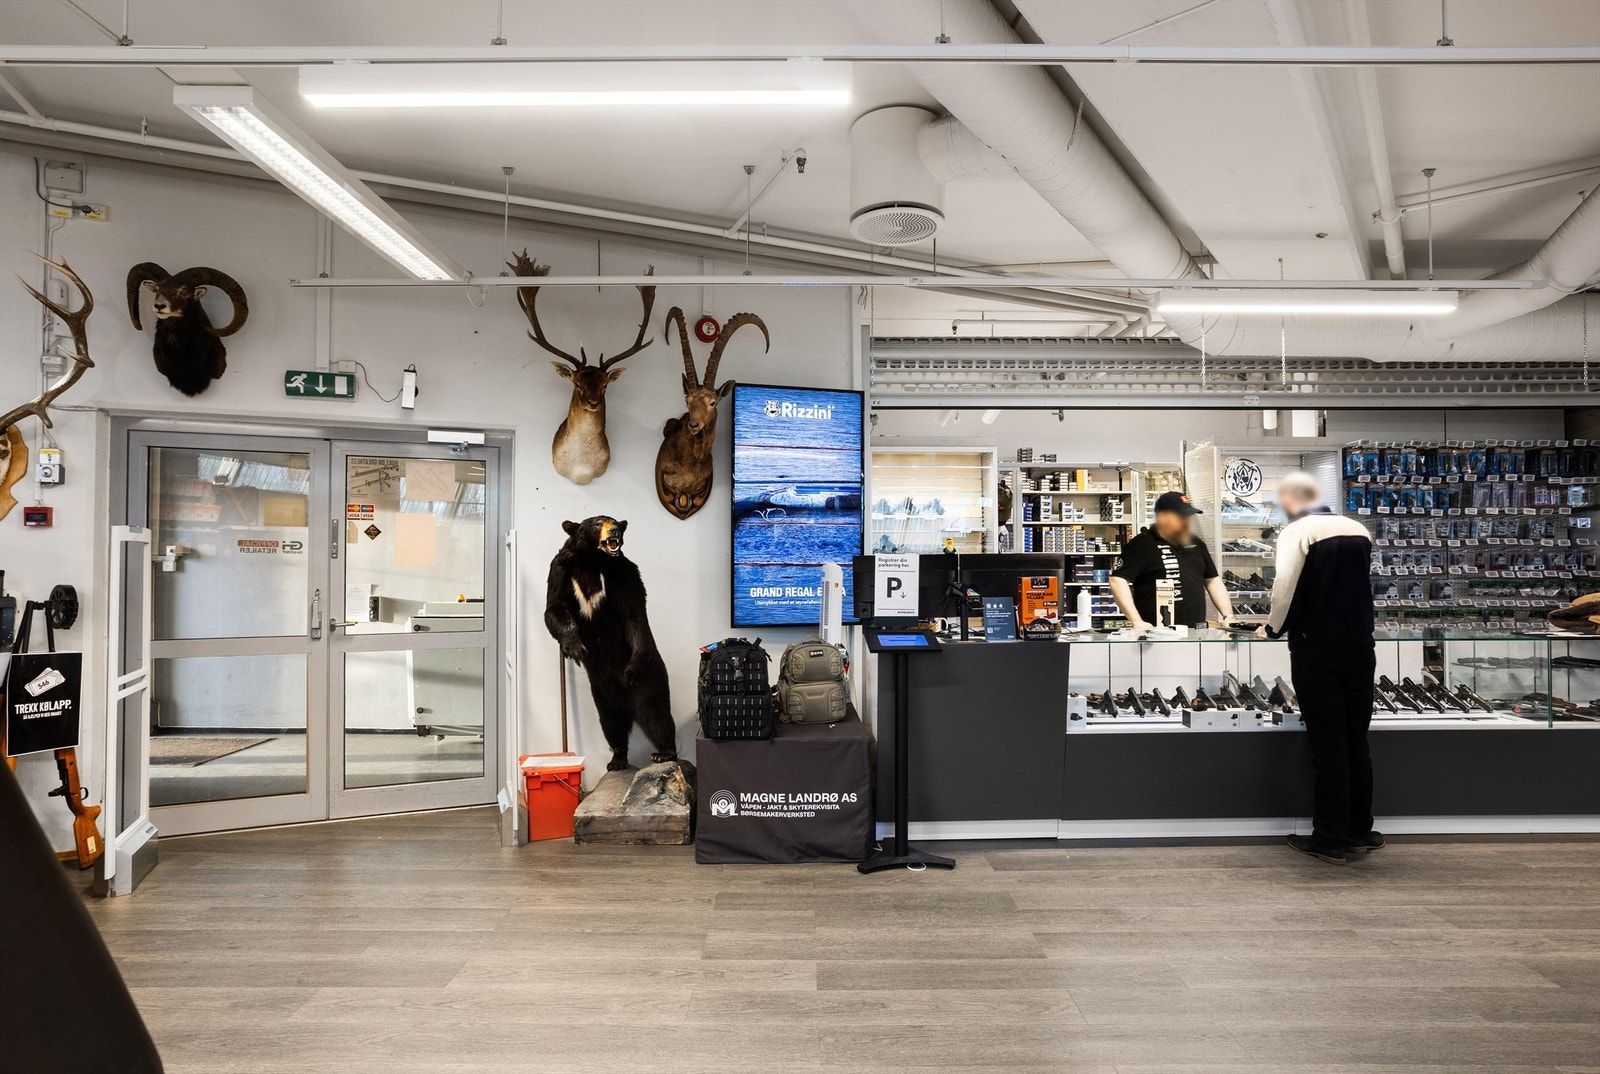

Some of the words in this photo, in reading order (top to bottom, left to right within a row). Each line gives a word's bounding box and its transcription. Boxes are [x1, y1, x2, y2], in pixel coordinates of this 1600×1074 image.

[781, 402, 832, 420] Rizzini
[750, 587, 783, 598] GRAND
[785, 587, 814, 597] REGAL
[886, 577, 902, 598] P
[14, 702, 38, 714] TREKK
[39, 699, 72, 712] KØLAPP.
[740, 793, 785, 803] MAGNE
[788, 792, 839, 803] LANDRØ
[841, 793, 857, 802] AS
